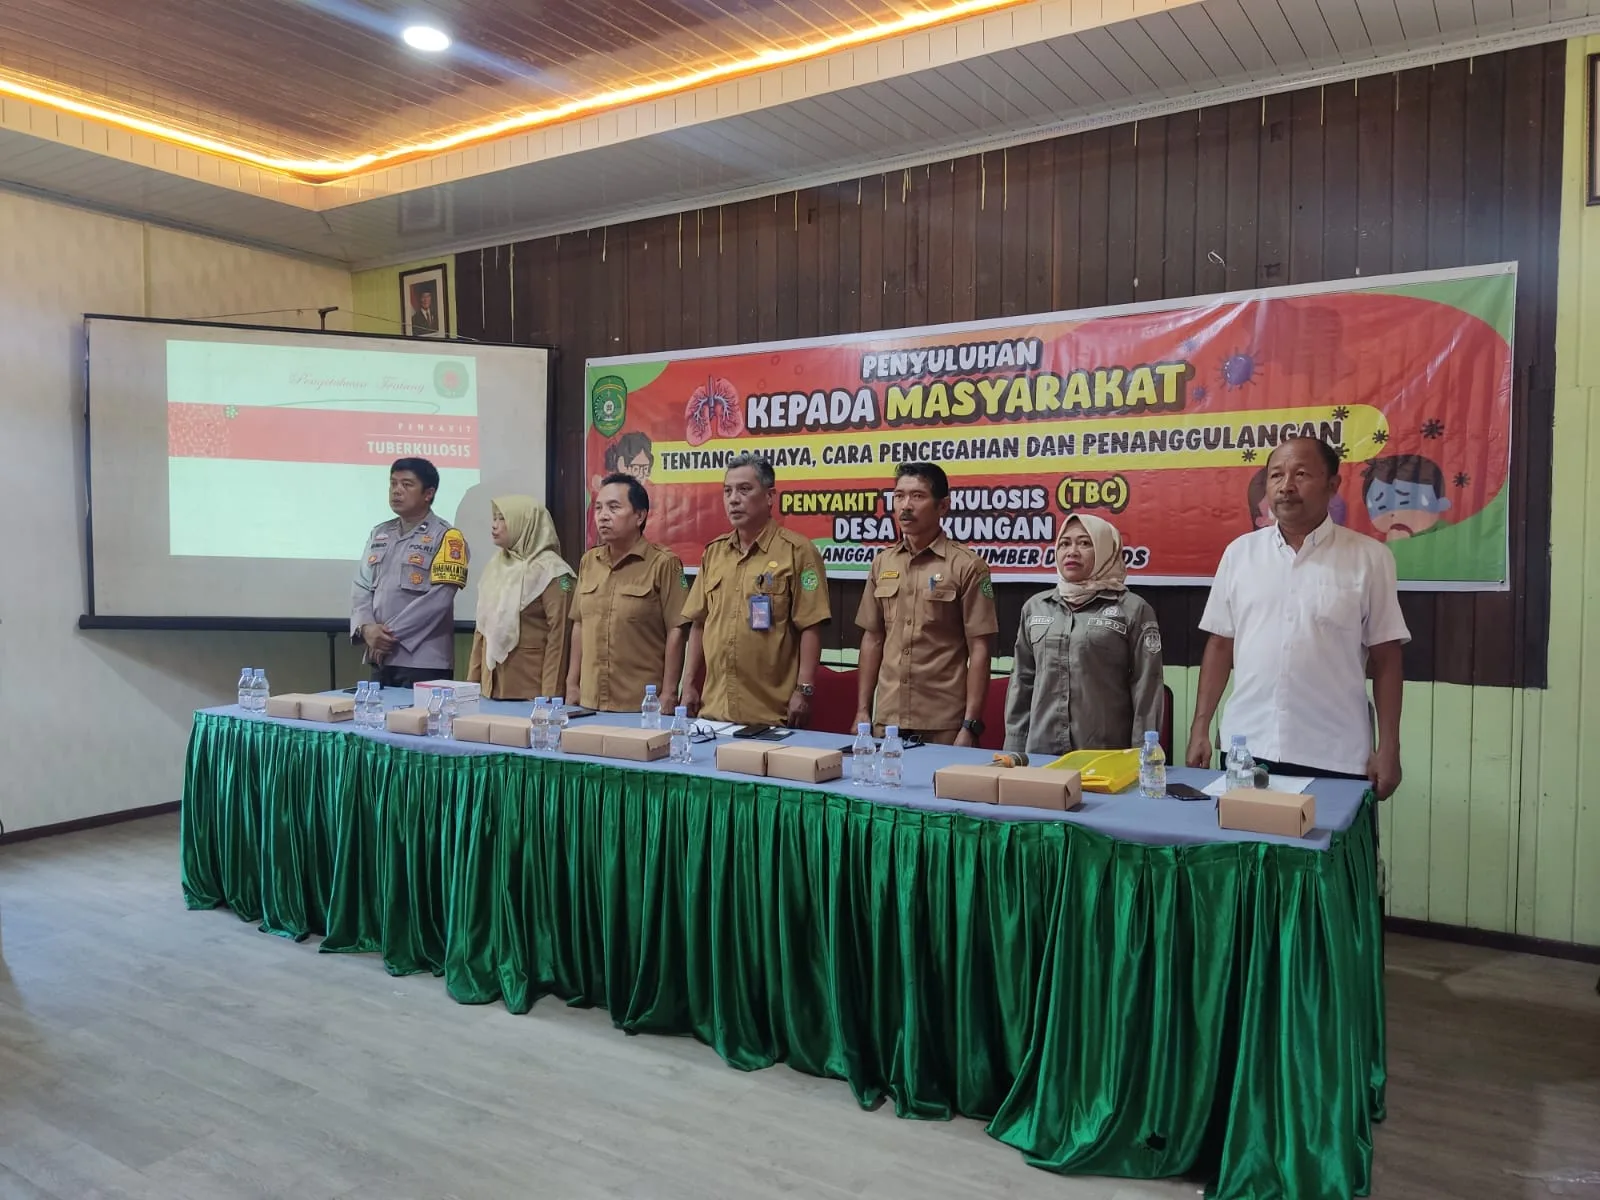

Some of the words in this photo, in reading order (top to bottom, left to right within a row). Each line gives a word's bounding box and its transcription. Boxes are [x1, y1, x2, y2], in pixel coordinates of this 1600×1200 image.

[862, 340, 1038, 379] PENYULUHAN
[747, 388, 876, 429] KEPADA
[886, 363, 1186, 421] MASYARAKAT
[367, 440, 471, 458] TUBERKULOSIS
[822, 444, 873, 465] CARA
[879, 436, 1019, 463] PENCEGAHAN
[1026, 434, 1075, 457] DAN
[1083, 421, 1342, 455] PENANGGULANGAN
[781, 491, 878, 513] PENYAKIT
[883, 488, 1045, 511] TKULOSIS
[1057, 476, 1128, 509] (TBC)
[835, 517, 895, 540] DESA
[408, 543, 433, 553] POLRI
[968, 548, 1040, 565] UMBER
